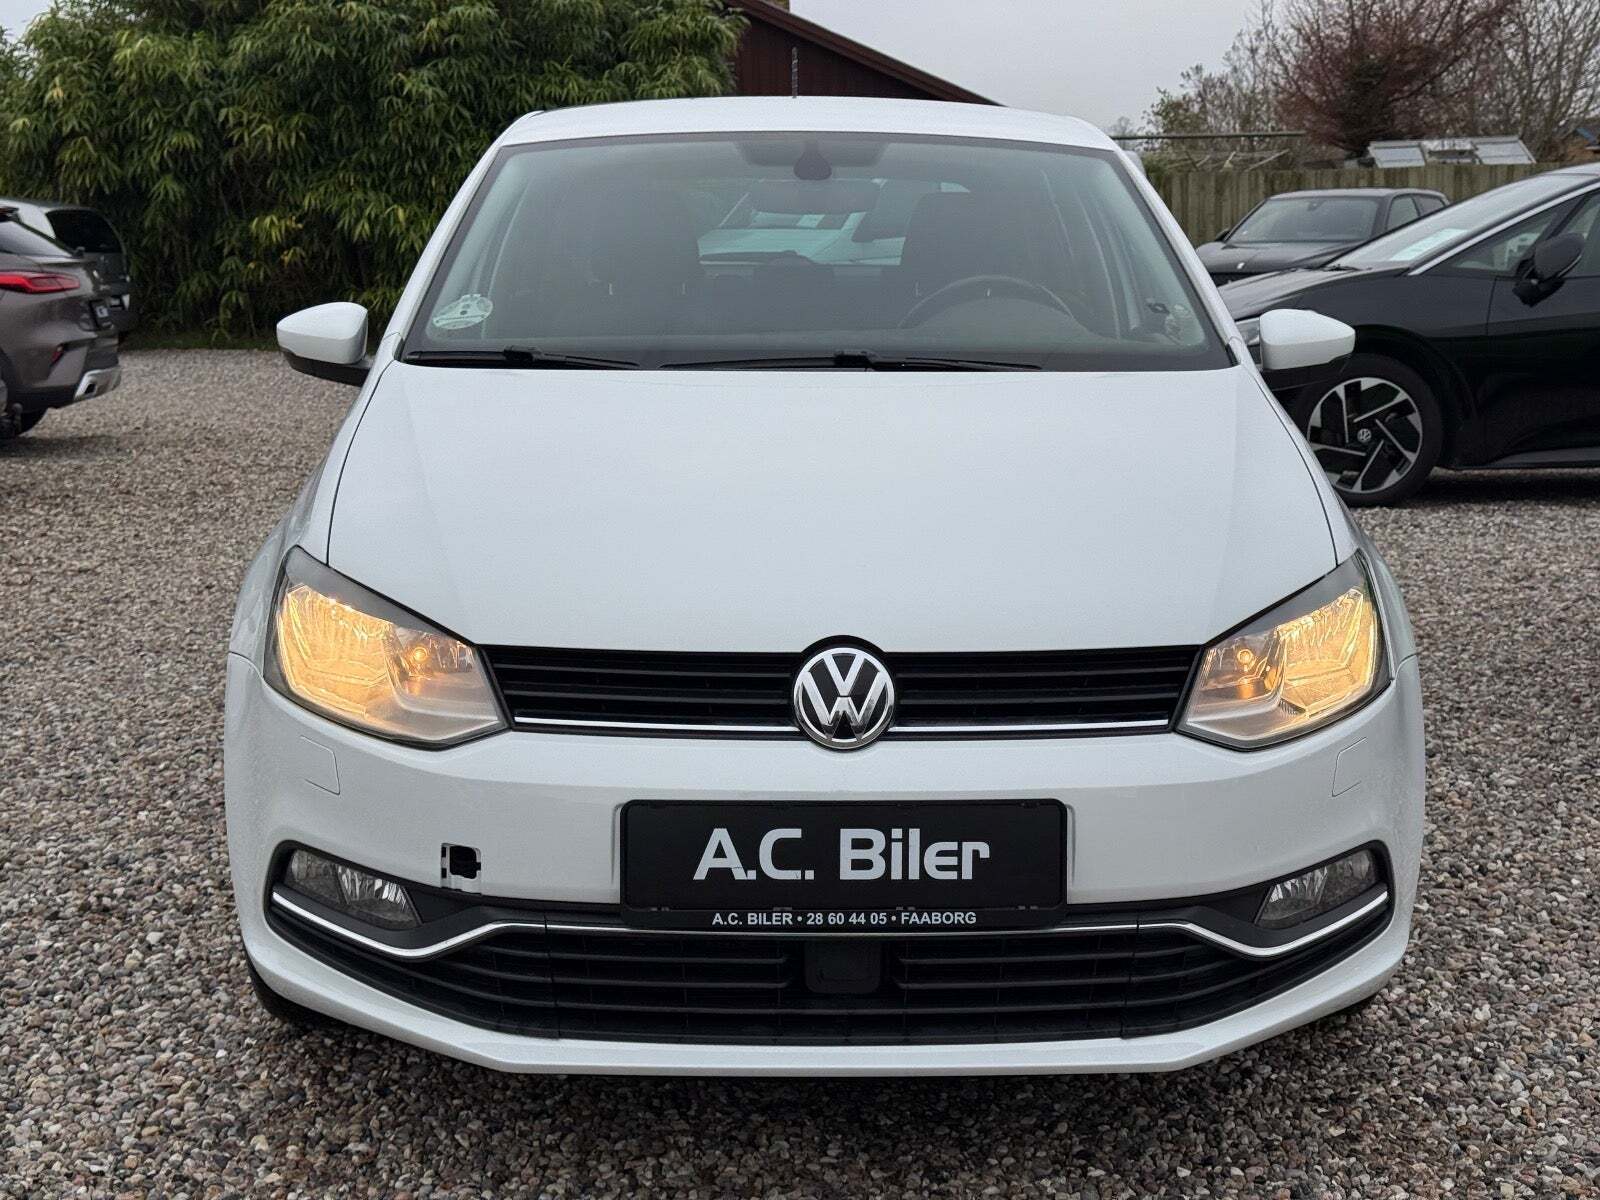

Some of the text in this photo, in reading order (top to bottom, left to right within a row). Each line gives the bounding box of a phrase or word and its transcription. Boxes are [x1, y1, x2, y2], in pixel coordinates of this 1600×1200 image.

[692, 827, 990, 880] A.C. Biler
[711, 910, 977, 926] A.C. BILER 28 60 44 05 FAABORG
